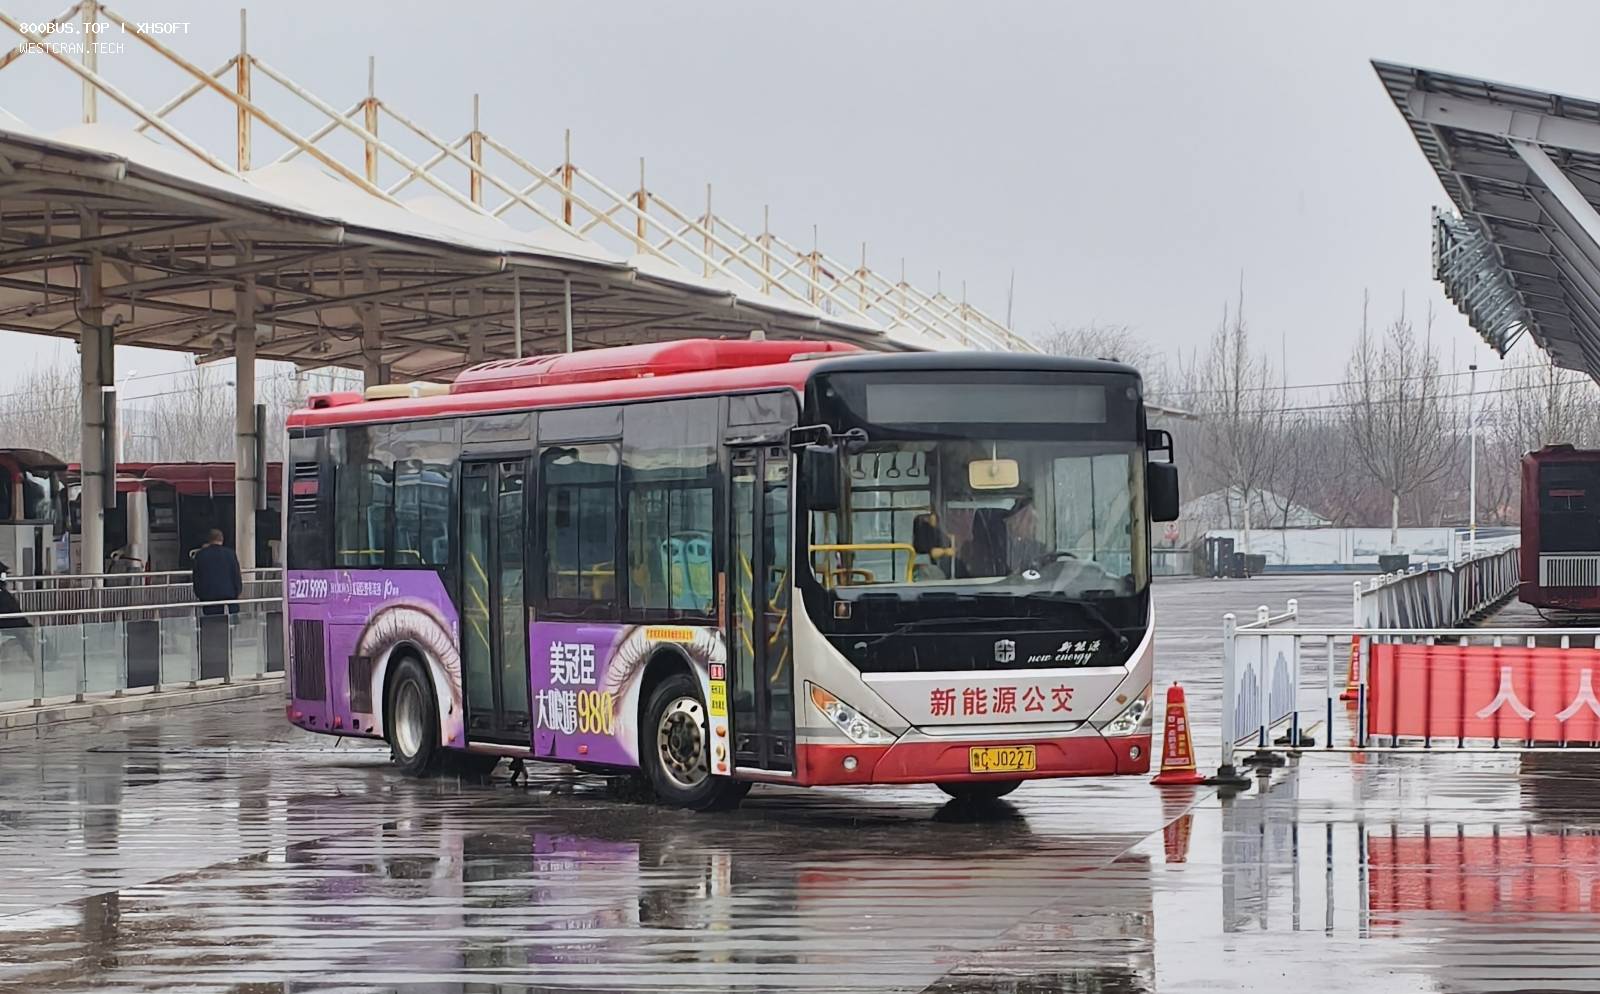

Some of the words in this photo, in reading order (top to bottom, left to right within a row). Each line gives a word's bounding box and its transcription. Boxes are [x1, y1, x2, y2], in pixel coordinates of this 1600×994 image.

[1027, 654, 1052, 663] new
[1055, 652, 1092, 665] energy
[1057, 639, 1101, 653] 新能源
[549, 640, 596, 685] 美冠臣
[535, 688, 578, 735] 大眼睛
[929, 684, 1075, 716] 新能源公交
